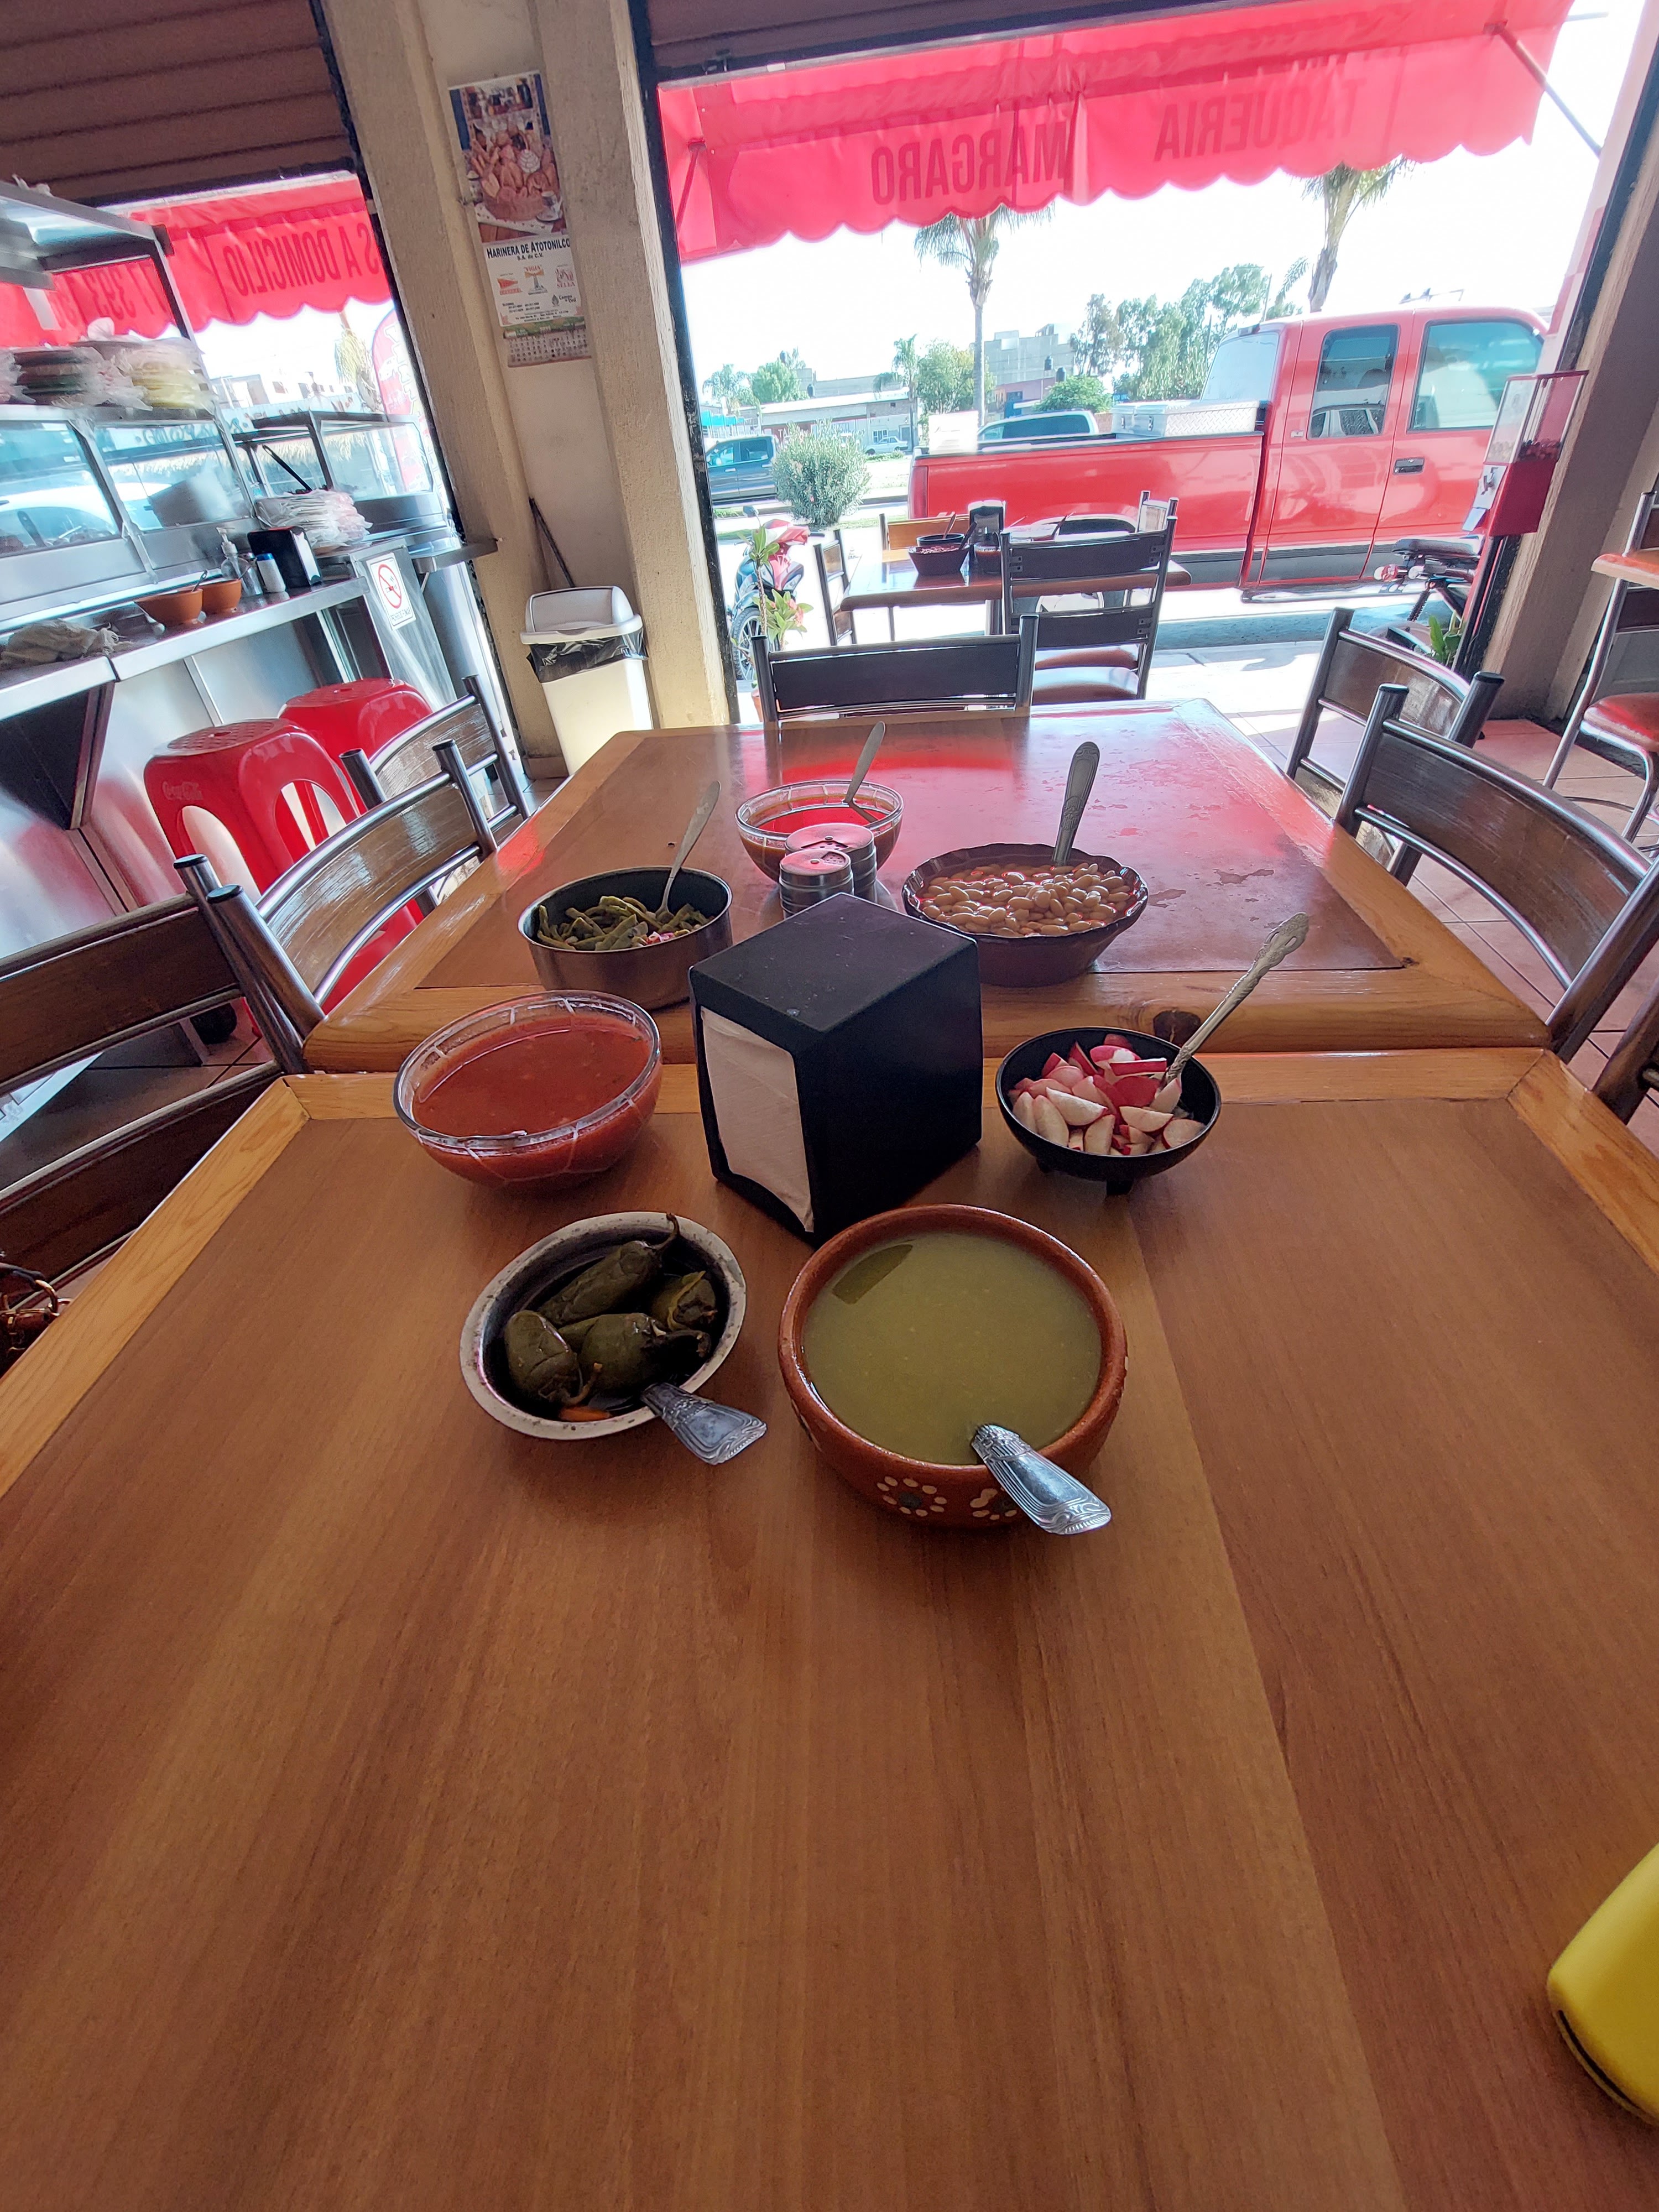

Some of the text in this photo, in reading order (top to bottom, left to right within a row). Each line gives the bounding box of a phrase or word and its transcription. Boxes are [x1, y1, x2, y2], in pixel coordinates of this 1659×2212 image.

[487, 238, 571, 259] HARINERA DE ATOTONILCO
